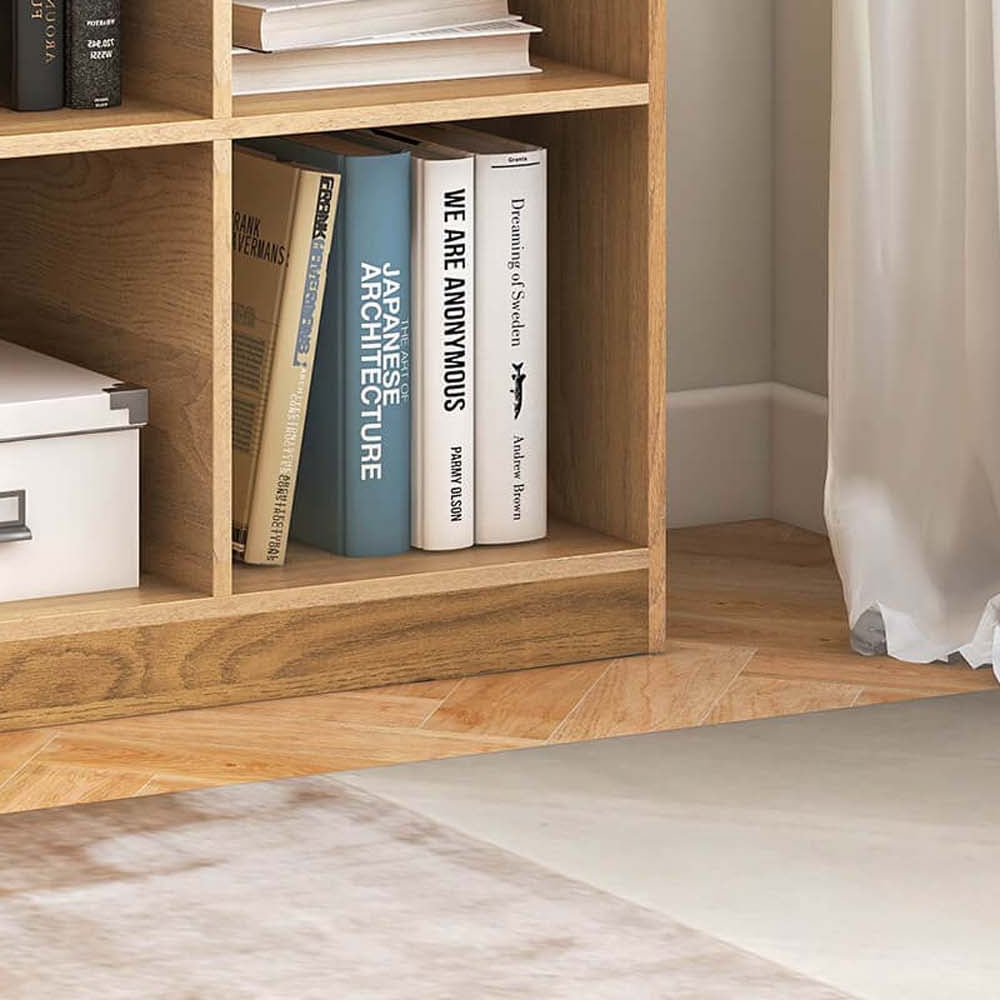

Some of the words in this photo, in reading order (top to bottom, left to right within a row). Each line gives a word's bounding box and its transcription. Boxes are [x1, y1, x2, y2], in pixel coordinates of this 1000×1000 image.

[232, 209, 261, 239] RANK
[443, 188, 466, 223] WE
[443, 230, 466, 271] ARE
[507, 198, 525, 272] Dreaming
[510, 273, 525, 289] of
[382, 262, 402, 407] JAPANESE
[510, 290, 525, 347] Sweden
[443, 277, 466, 412] ANONYMOUS
[360, 262, 383, 481] ARCHITECTURE
[450, 446, 462, 484] PARMY
[511, 434, 525, 481] Andrew
[450, 487, 462, 522] OLSON
[511, 484, 525, 521] Brown
